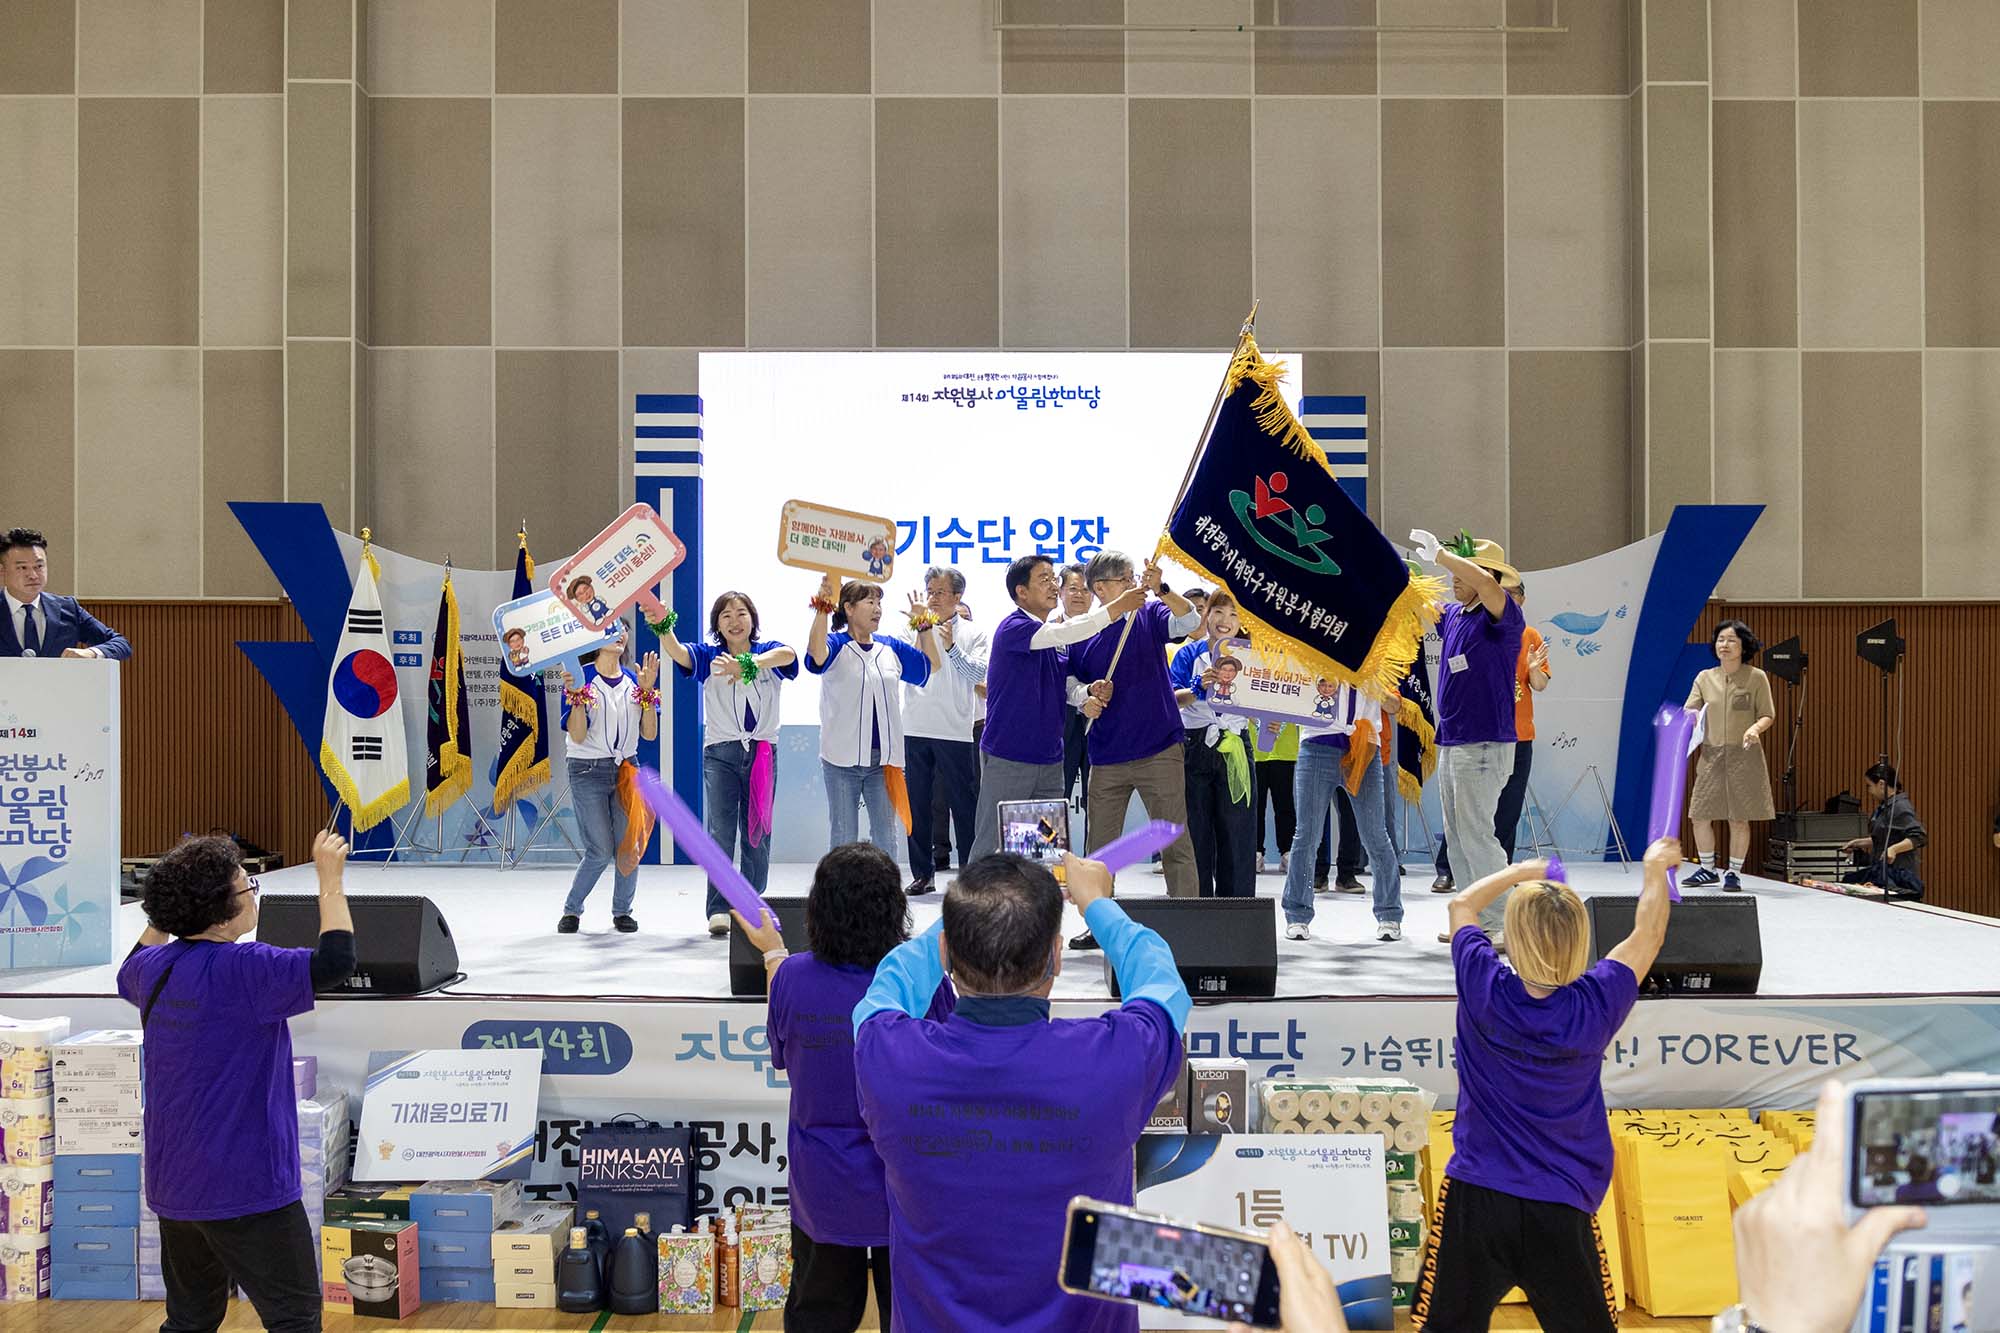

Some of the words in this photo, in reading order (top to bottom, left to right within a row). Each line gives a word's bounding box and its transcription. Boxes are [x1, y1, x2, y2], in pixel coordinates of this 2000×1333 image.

[901, 393, 929, 403] 제14회
[932, 387, 993, 408] 자원봉사
[995, 385, 1101, 410] 어울림한마당
[790, 532, 800, 545] 더
[801, 535, 820, 549] 좋은
[895, 515, 1016, 565] 기수단
[1029, 516, 1110, 565] 입장
[595, 561, 613, 581] 든든
[604, 566, 634, 590] 구민이
[1234, 557, 1265, 594] 대덕구
[1261, 580, 1313, 624] 자원봉사
[1310, 606, 1349, 643] 협의회
[399, 632, 417, 643] 주최
[540, 627, 562, 644] 든든
[399, 655, 417, 665] 후원
[1250, 679, 1280, 695] 든든한
[1281, 684, 1301, 697] 대덕
[1341, 1035, 1458, 1072] 가슴뛰
[1657, 1033, 1862, 1066] FOREVER
[391, 1101, 509, 1124] 기채움의료기
[582, 1147, 685, 1165] HIMALAYA
[581, 1163, 685, 1181] PINKSALT
[1235, 1190, 1285, 1228] 1등
[1323, 1232, 1368, 1260] TV)
